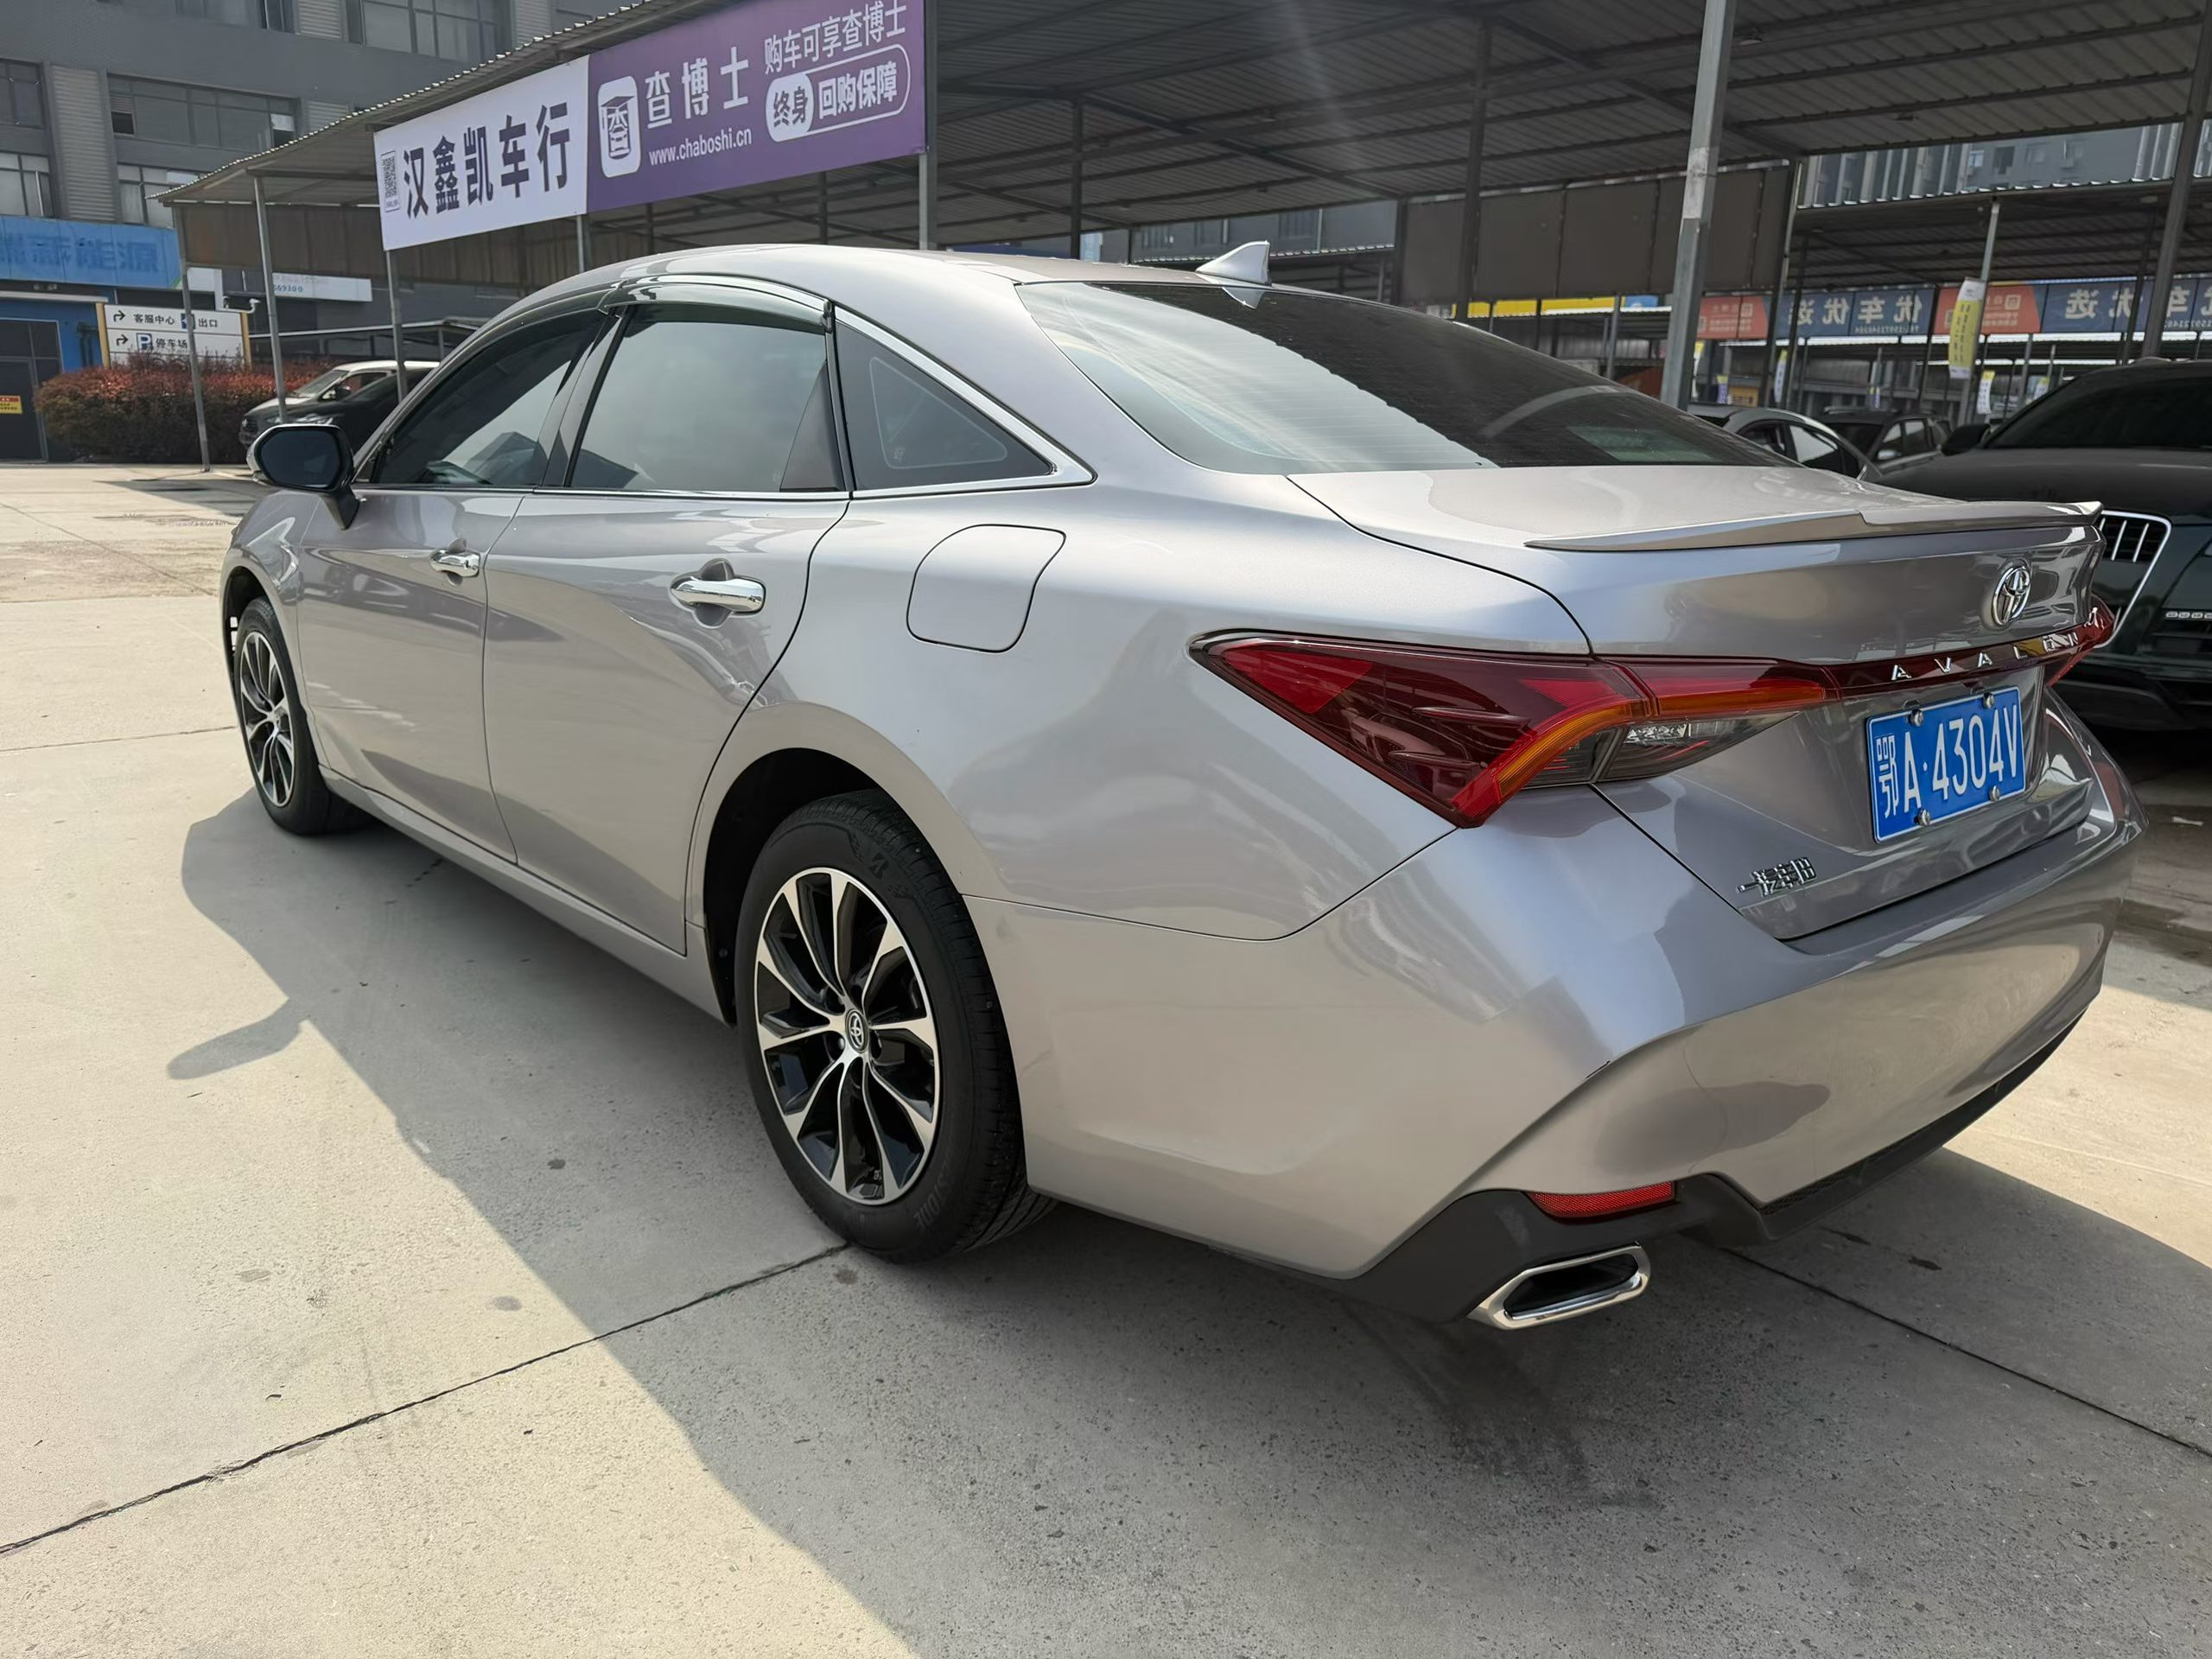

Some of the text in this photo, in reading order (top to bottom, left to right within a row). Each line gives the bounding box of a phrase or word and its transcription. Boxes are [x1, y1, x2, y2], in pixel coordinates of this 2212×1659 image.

[765, 0, 907, 74] 购车可享查博士
[645, 47, 749, 129] 查博士
[773, 61, 898, 128] 终身 回购保障
[403, 100, 569, 219] 汉鑫凯车行
[648, 127, 752, 166] www.chaboshi.cn
[134, 314, 218, 328] 客服中心 出口
[156, 337, 188, 349] 停车场
[1876, 704, 2018, 818] 鄂A·4304V
